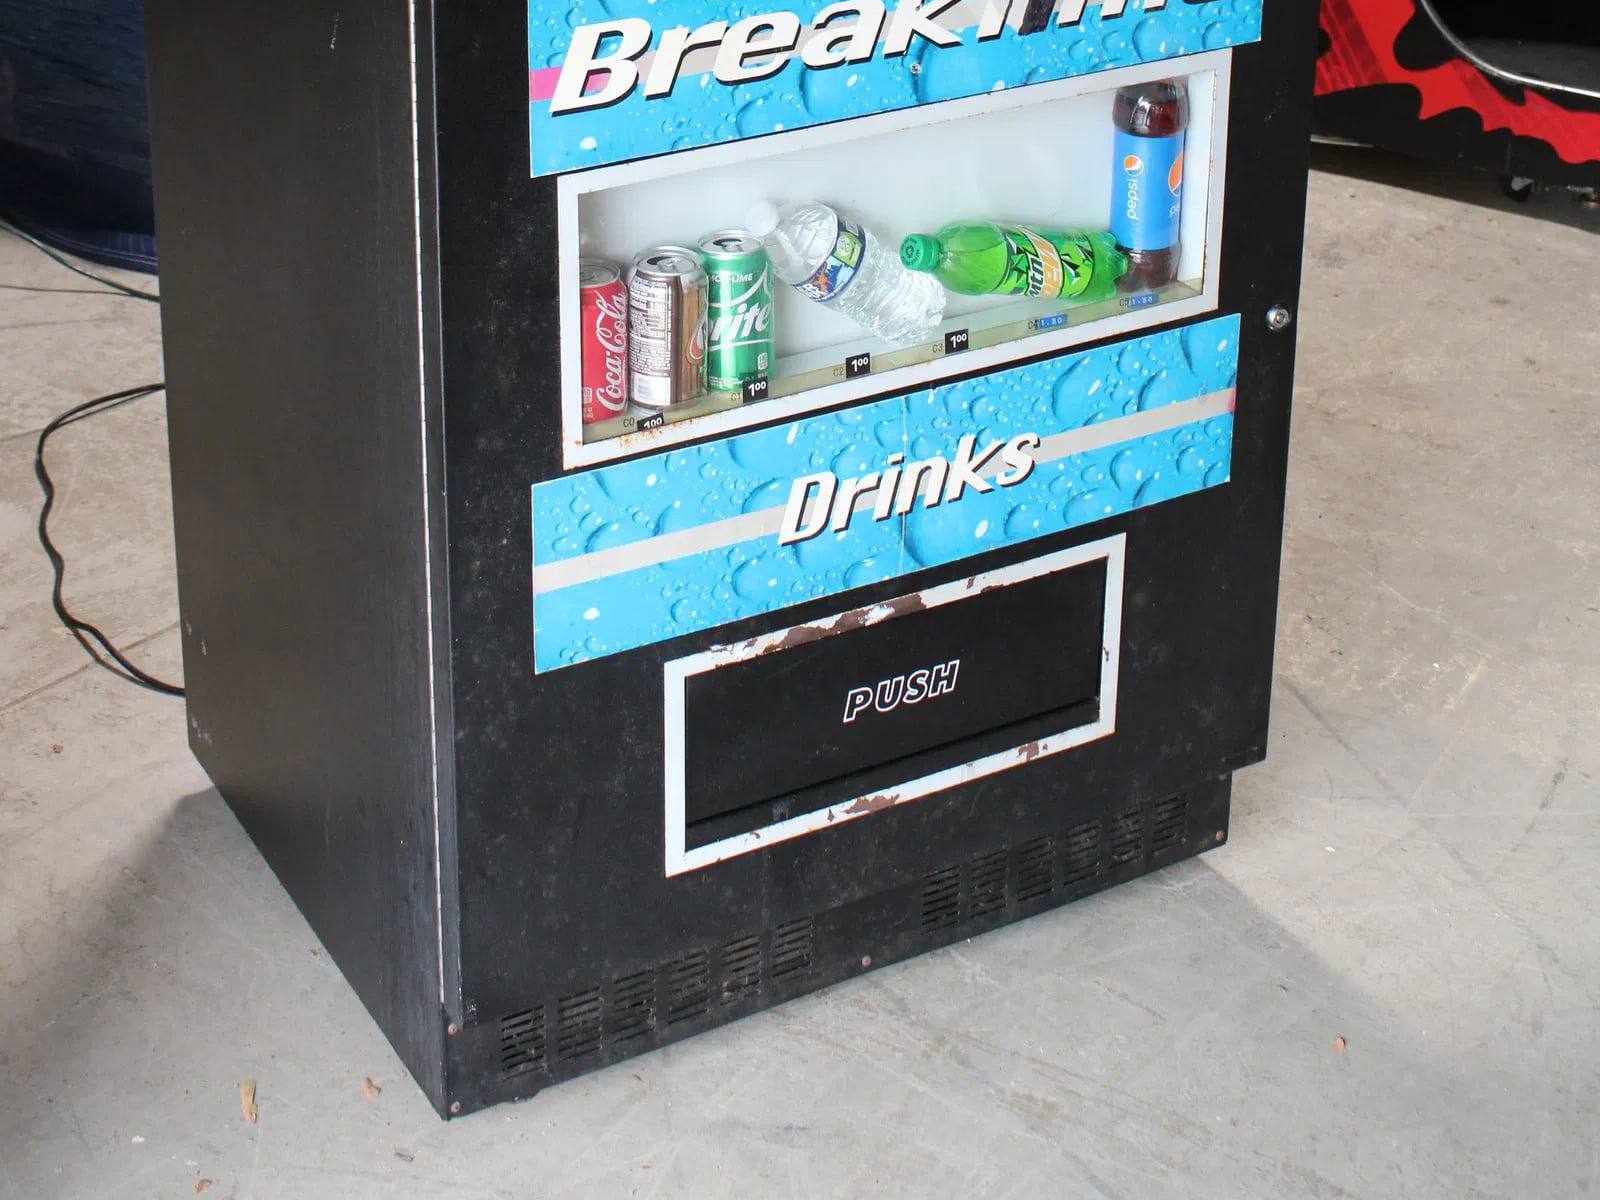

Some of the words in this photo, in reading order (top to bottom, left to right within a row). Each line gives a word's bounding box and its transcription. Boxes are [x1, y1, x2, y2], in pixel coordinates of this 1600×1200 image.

[1126, 178, 1140, 220] pepsi
[708, 302, 771, 341] rite
[932, 343, 943, 353] C3
[833, 366, 844, 377] C2
[777, 432, 1041, 547] Drinks
[843, 659, 960, 723] PUSH
